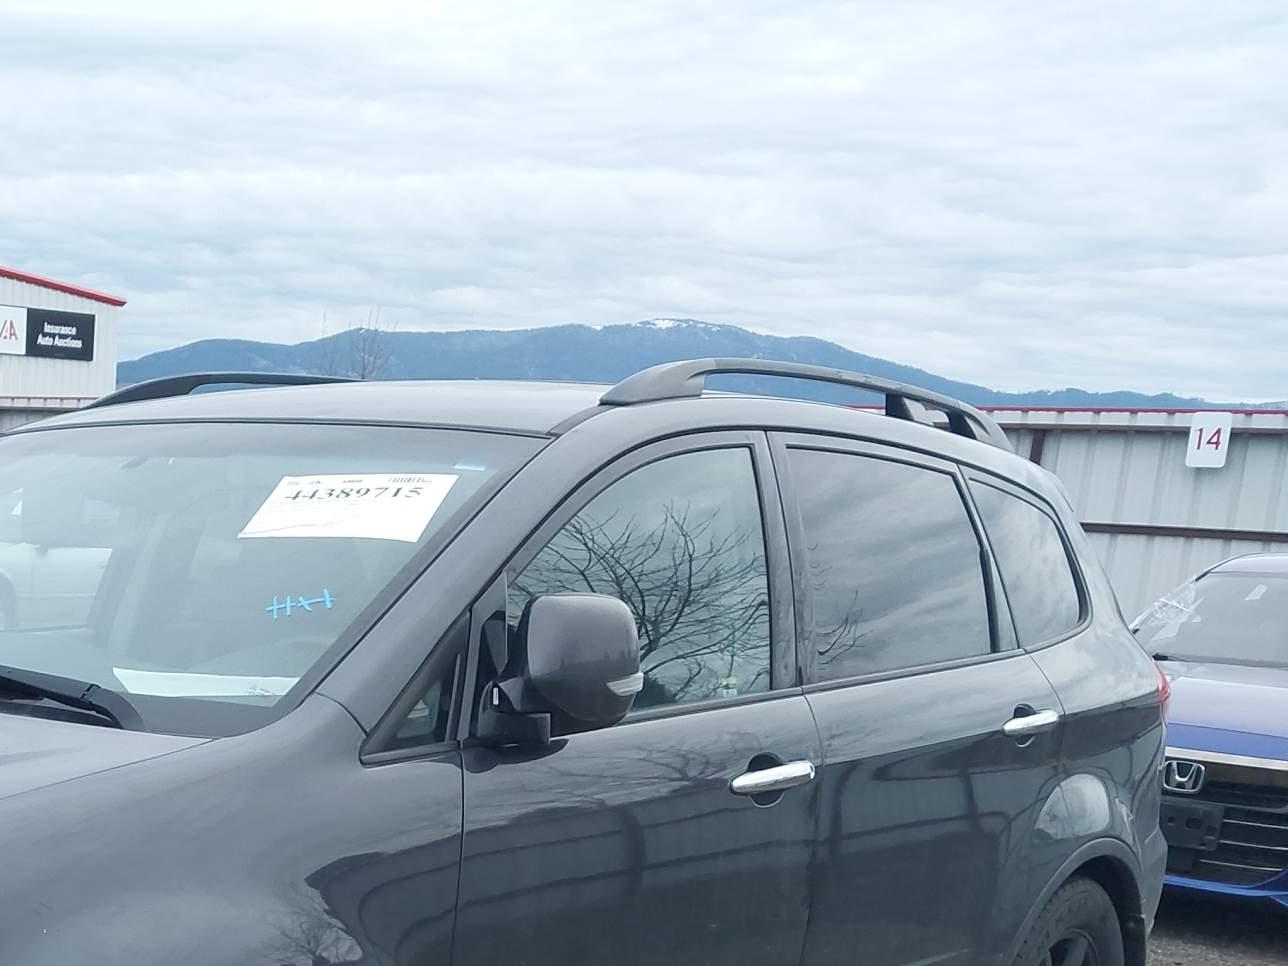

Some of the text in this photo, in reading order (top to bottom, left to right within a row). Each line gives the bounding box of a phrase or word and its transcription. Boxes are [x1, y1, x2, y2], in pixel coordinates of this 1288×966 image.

[43, 321, 77, 335] Insurance
[37, 333, 83, 348] Auto Auctions
[1195, 427, 1222, 450] 14
[284, 487, 425, 501] 44389715
